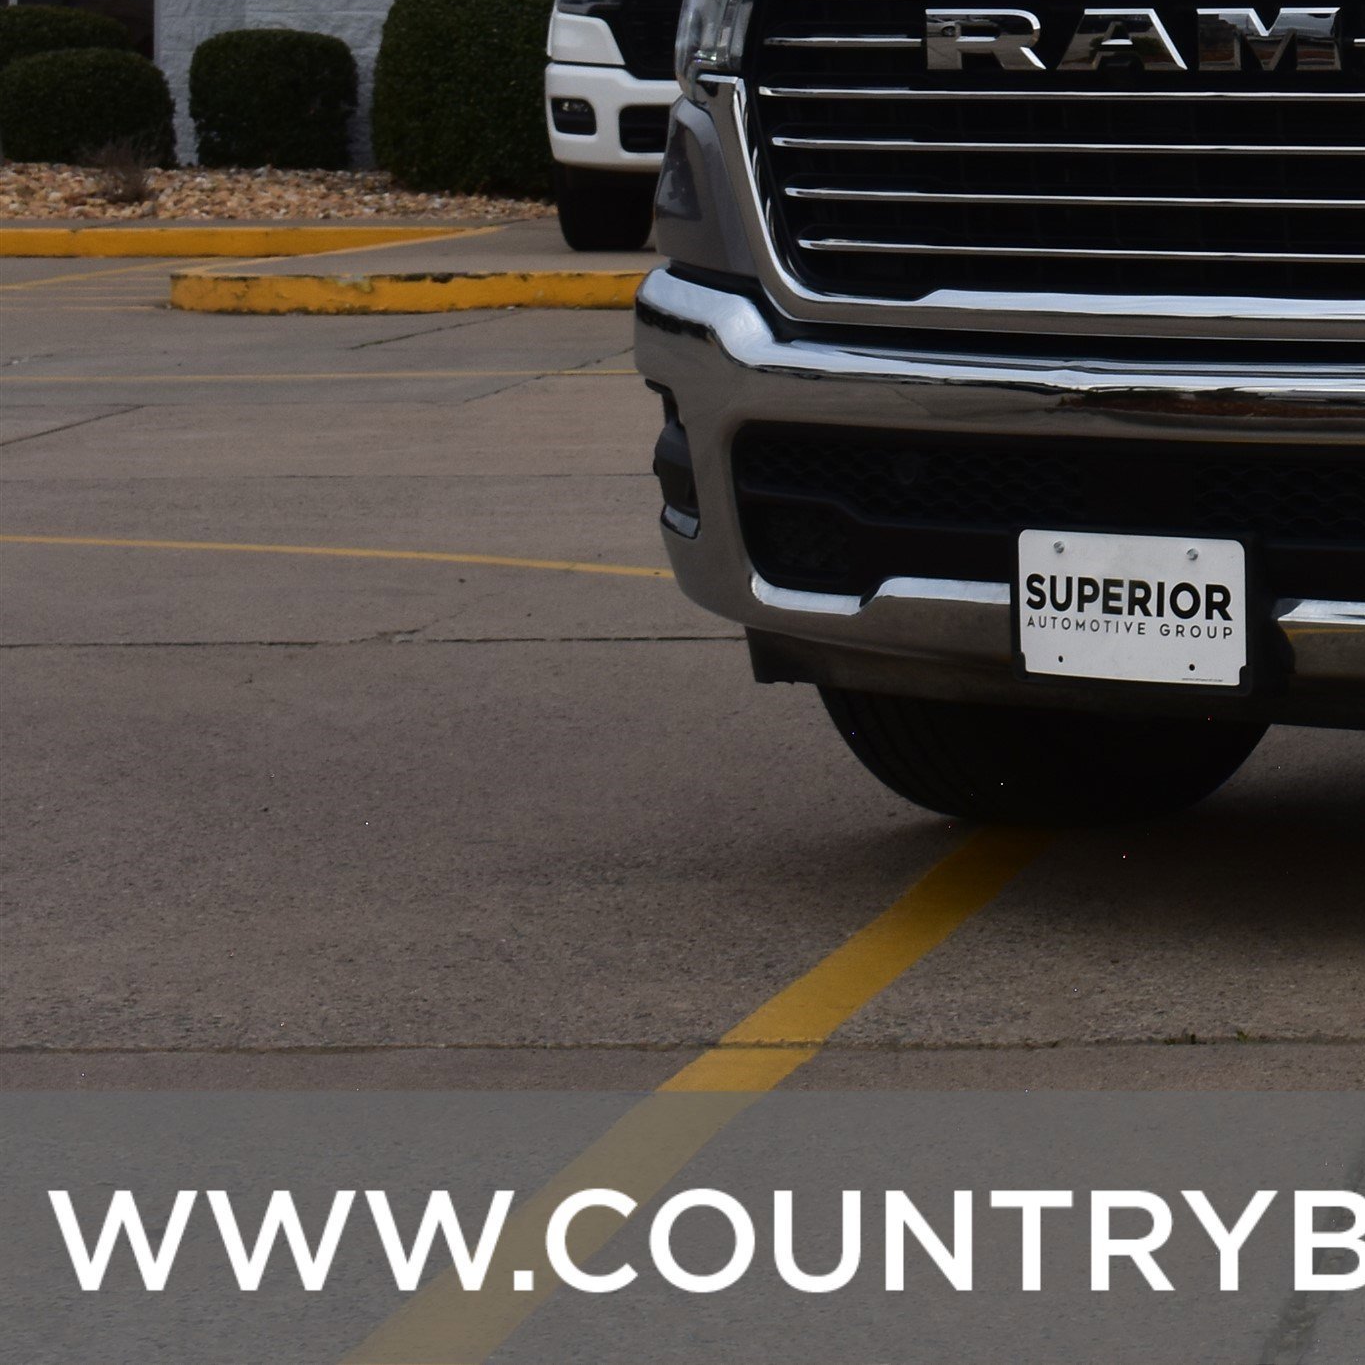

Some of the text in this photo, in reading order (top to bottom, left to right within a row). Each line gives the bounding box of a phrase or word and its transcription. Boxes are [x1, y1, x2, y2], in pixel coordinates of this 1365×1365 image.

[925, 7, 1342, 70] RAM
[1026, 573, 1233, 621] SUPERIOR
[1027, 615, 1234, 640] AUTOMOTIVE GROUP
